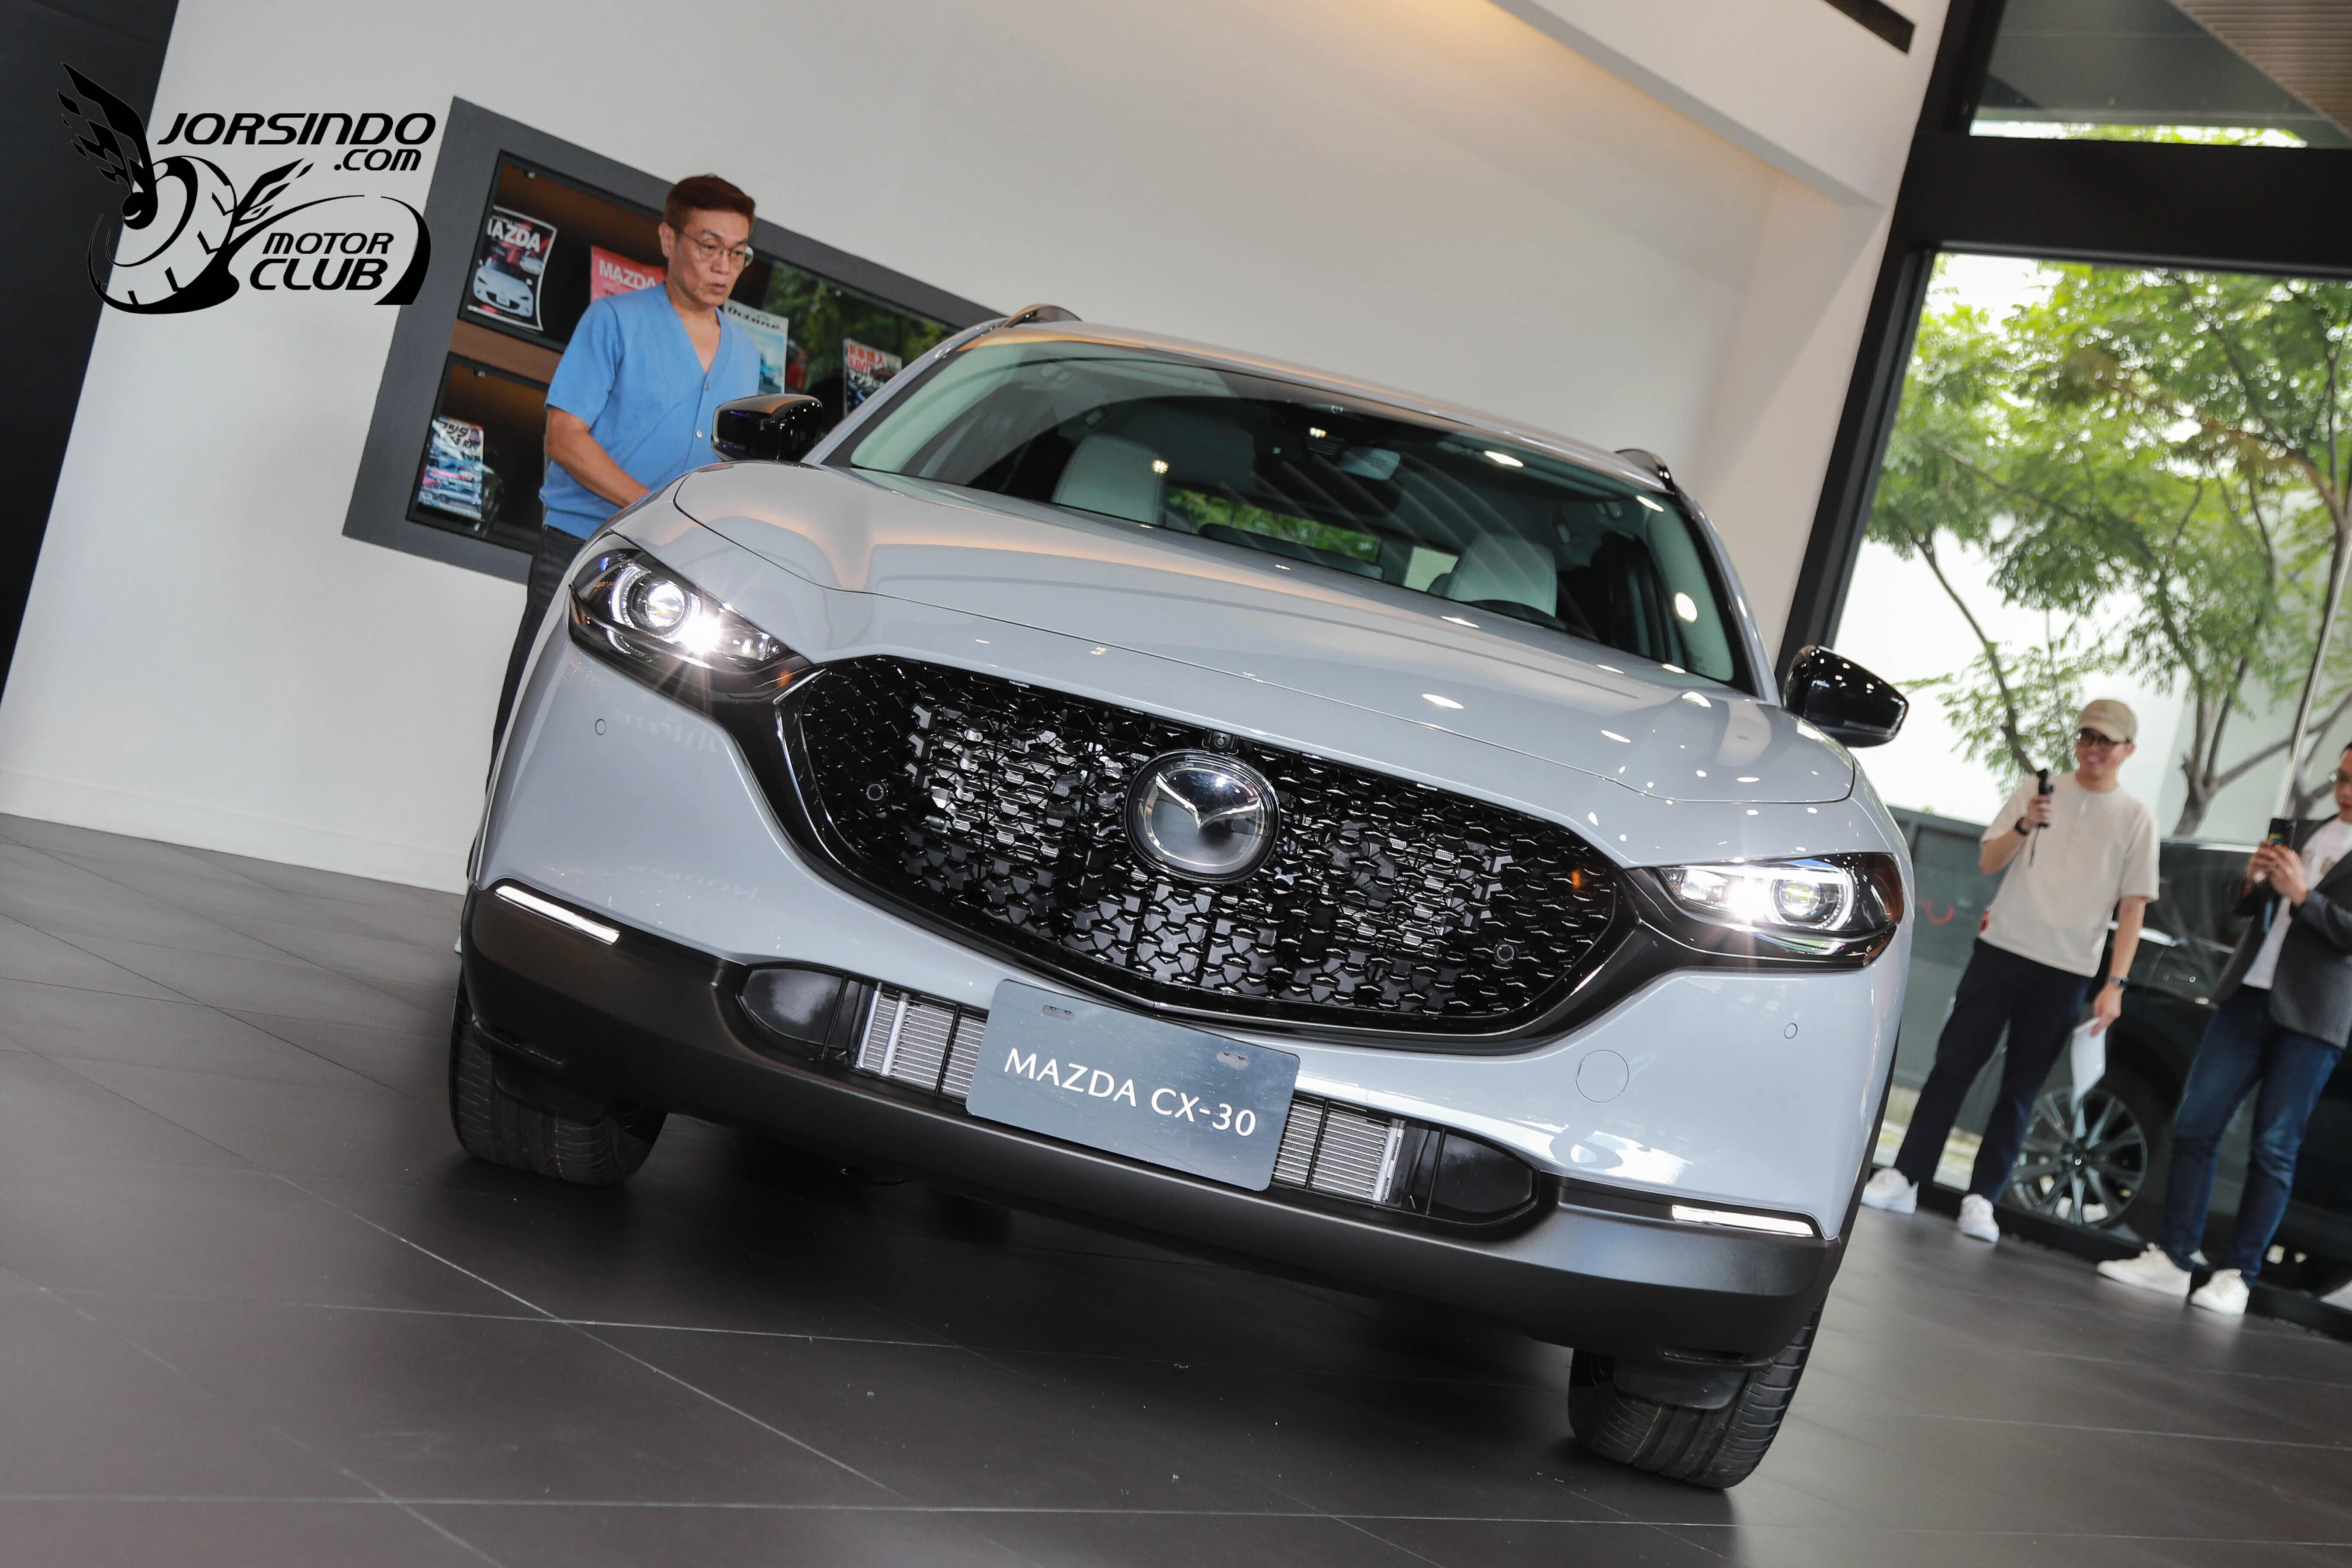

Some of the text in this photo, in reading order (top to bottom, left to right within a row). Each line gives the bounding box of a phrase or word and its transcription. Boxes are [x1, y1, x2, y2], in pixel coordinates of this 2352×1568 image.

[599, 259, 657, 290] MAZDA
[1004, 1048, 1256, 1137] MAZDA CX-30
